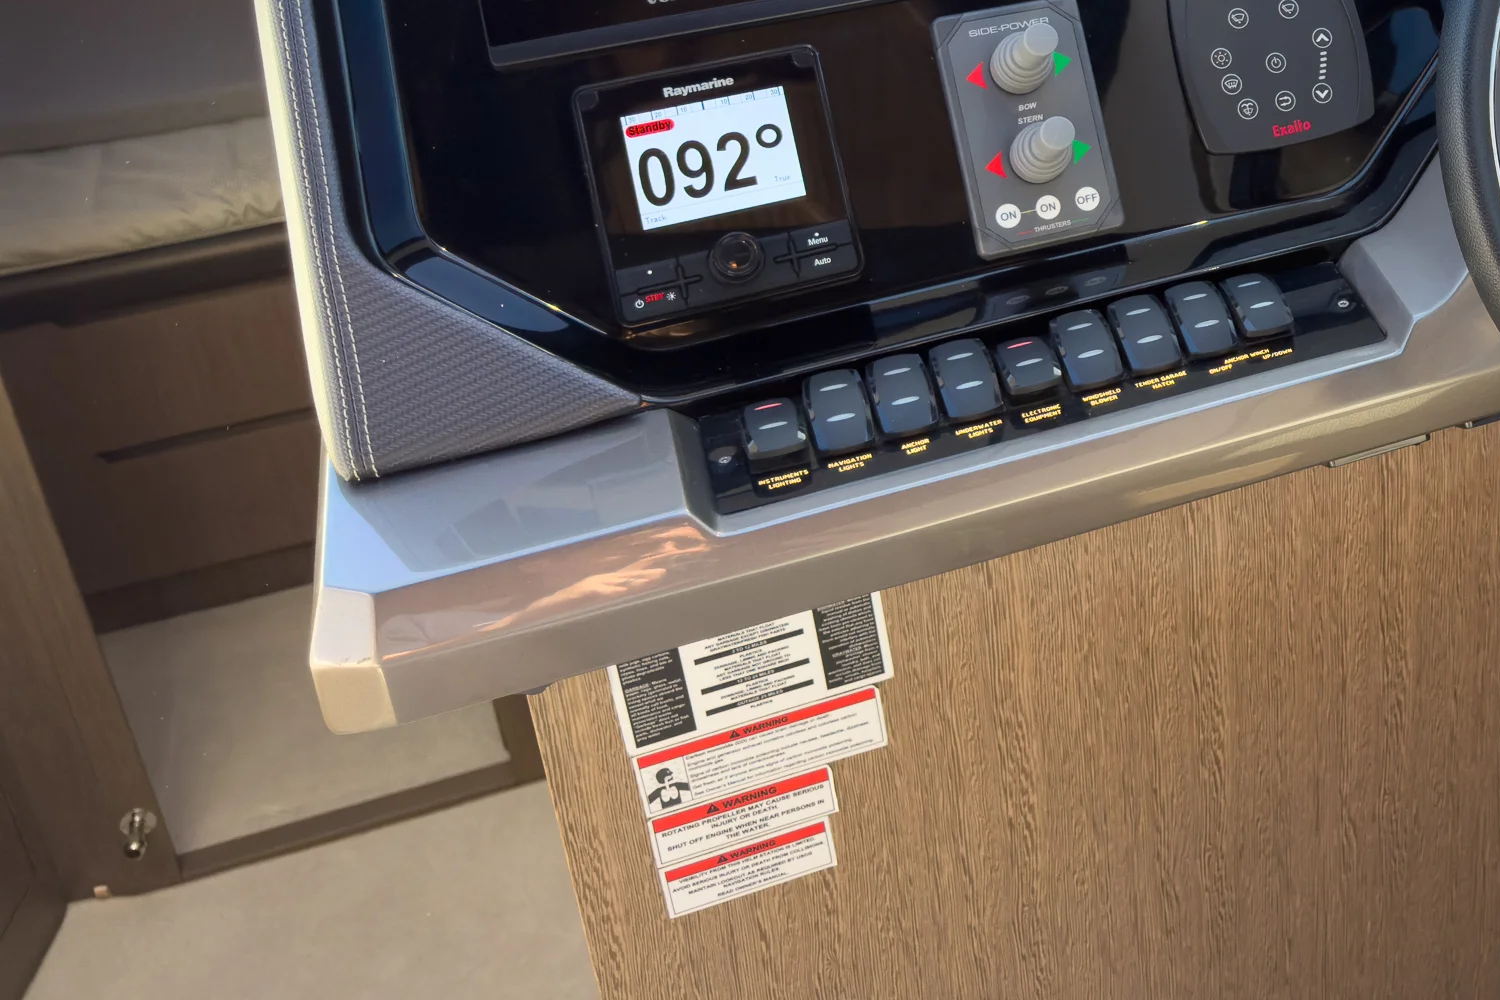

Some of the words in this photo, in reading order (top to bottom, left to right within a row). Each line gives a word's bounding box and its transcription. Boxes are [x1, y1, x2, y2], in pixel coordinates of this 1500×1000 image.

[968, 16, 1049, 38] SIDE-POWER
[663, 76, 734, 98] Raymarine
[1018, 102, 1037, 111] BOW
[1017, 114, 1043, 125] STERN
[628, 119, 671, 136] Standby
[638, 123, 783, 207] 092°
[774, 173, 791, 182] True
[1077, 193, 1097, 205] OFF
[1000, 211, 1017, 221] ON
[1040, 202, 1056, 212] ON
[645, 214, 667, 224] Track
[1034, 219, 1072, 233] THRUSTERS
[808, 235, 828, 246] Menu
[814, 256, 831, 266] Auto
[1224, 354, 1249, 365] ANCHOR
[1250, 348, 1270, 358] WINCH
[1262, 348, 1293, 360] UP/DOWN
[1209, 364, 1233, 375] ON/OFF
[1135, 378, 1159, 388] TENDER
[1160, 370, 1187, 382] GARAGE
[1152, 379, 1175, 390] HATCH
[1082, 387, 1121, 403] WINDSHIELD
[1090, 394, 1118, 407] BLOWER
[1021, 403, 1061, 418] ELECTRONIC
[1024, 410, 1062, 424] EQUIPMENT
[955, 419, 1003, 436] UNDERWATER
[968, 427, 994, 439] LIGHTS
[901, 438, 930, 450] ANCHOR
[906, 444, 927, 455] LIGHT
[827, 453, 872, 469] NAVIGATION
[838, 461, 865, 472] LIGHTS
[758, 469, 809, 486] INSTRUMENTS
[768, 477, 802, 490] LIGHTING
[743, 716, 789, 735] WARNING
[722, 786, 777, 808] WARNING
[661, 822, 700, 838] ROTATING
[702, 808, 746, 825] PROPELLER
[747, 802, 764, 811] MAY
[766, 795, 791, 805] CAUSE
[793, 784, 824, 797] SERIOUS
[667, 841, 687, 852] SHUT
[689, 836, 704, 845] OFF
[705, 827, 735, 840] ENGINE
[735, 819, 758, 830] WHEN
[759, 812, 779, 823] NEAR
[781, 802, 816, 816] PERSONS
[711, 817, 737, 829] INJURY
[739, 812, 751, 820] OR
[725, 831, 740, 839] THE
[730, 840, 776, 859] WARNING
[710, 866, 726, 874] FROM
[741, 855, 758, 864] HELM
[760, 847, 784, 858] STATION
[672, 884, 691, 893] AVOID
[692, 876, 718, 887] SERIOUS
[719, 868, 740, 878] INJURY
[751, 857, 771, 868] DEATH
[772, 852, 789, 861] FROM
[717, 888, 734, 897] READ
